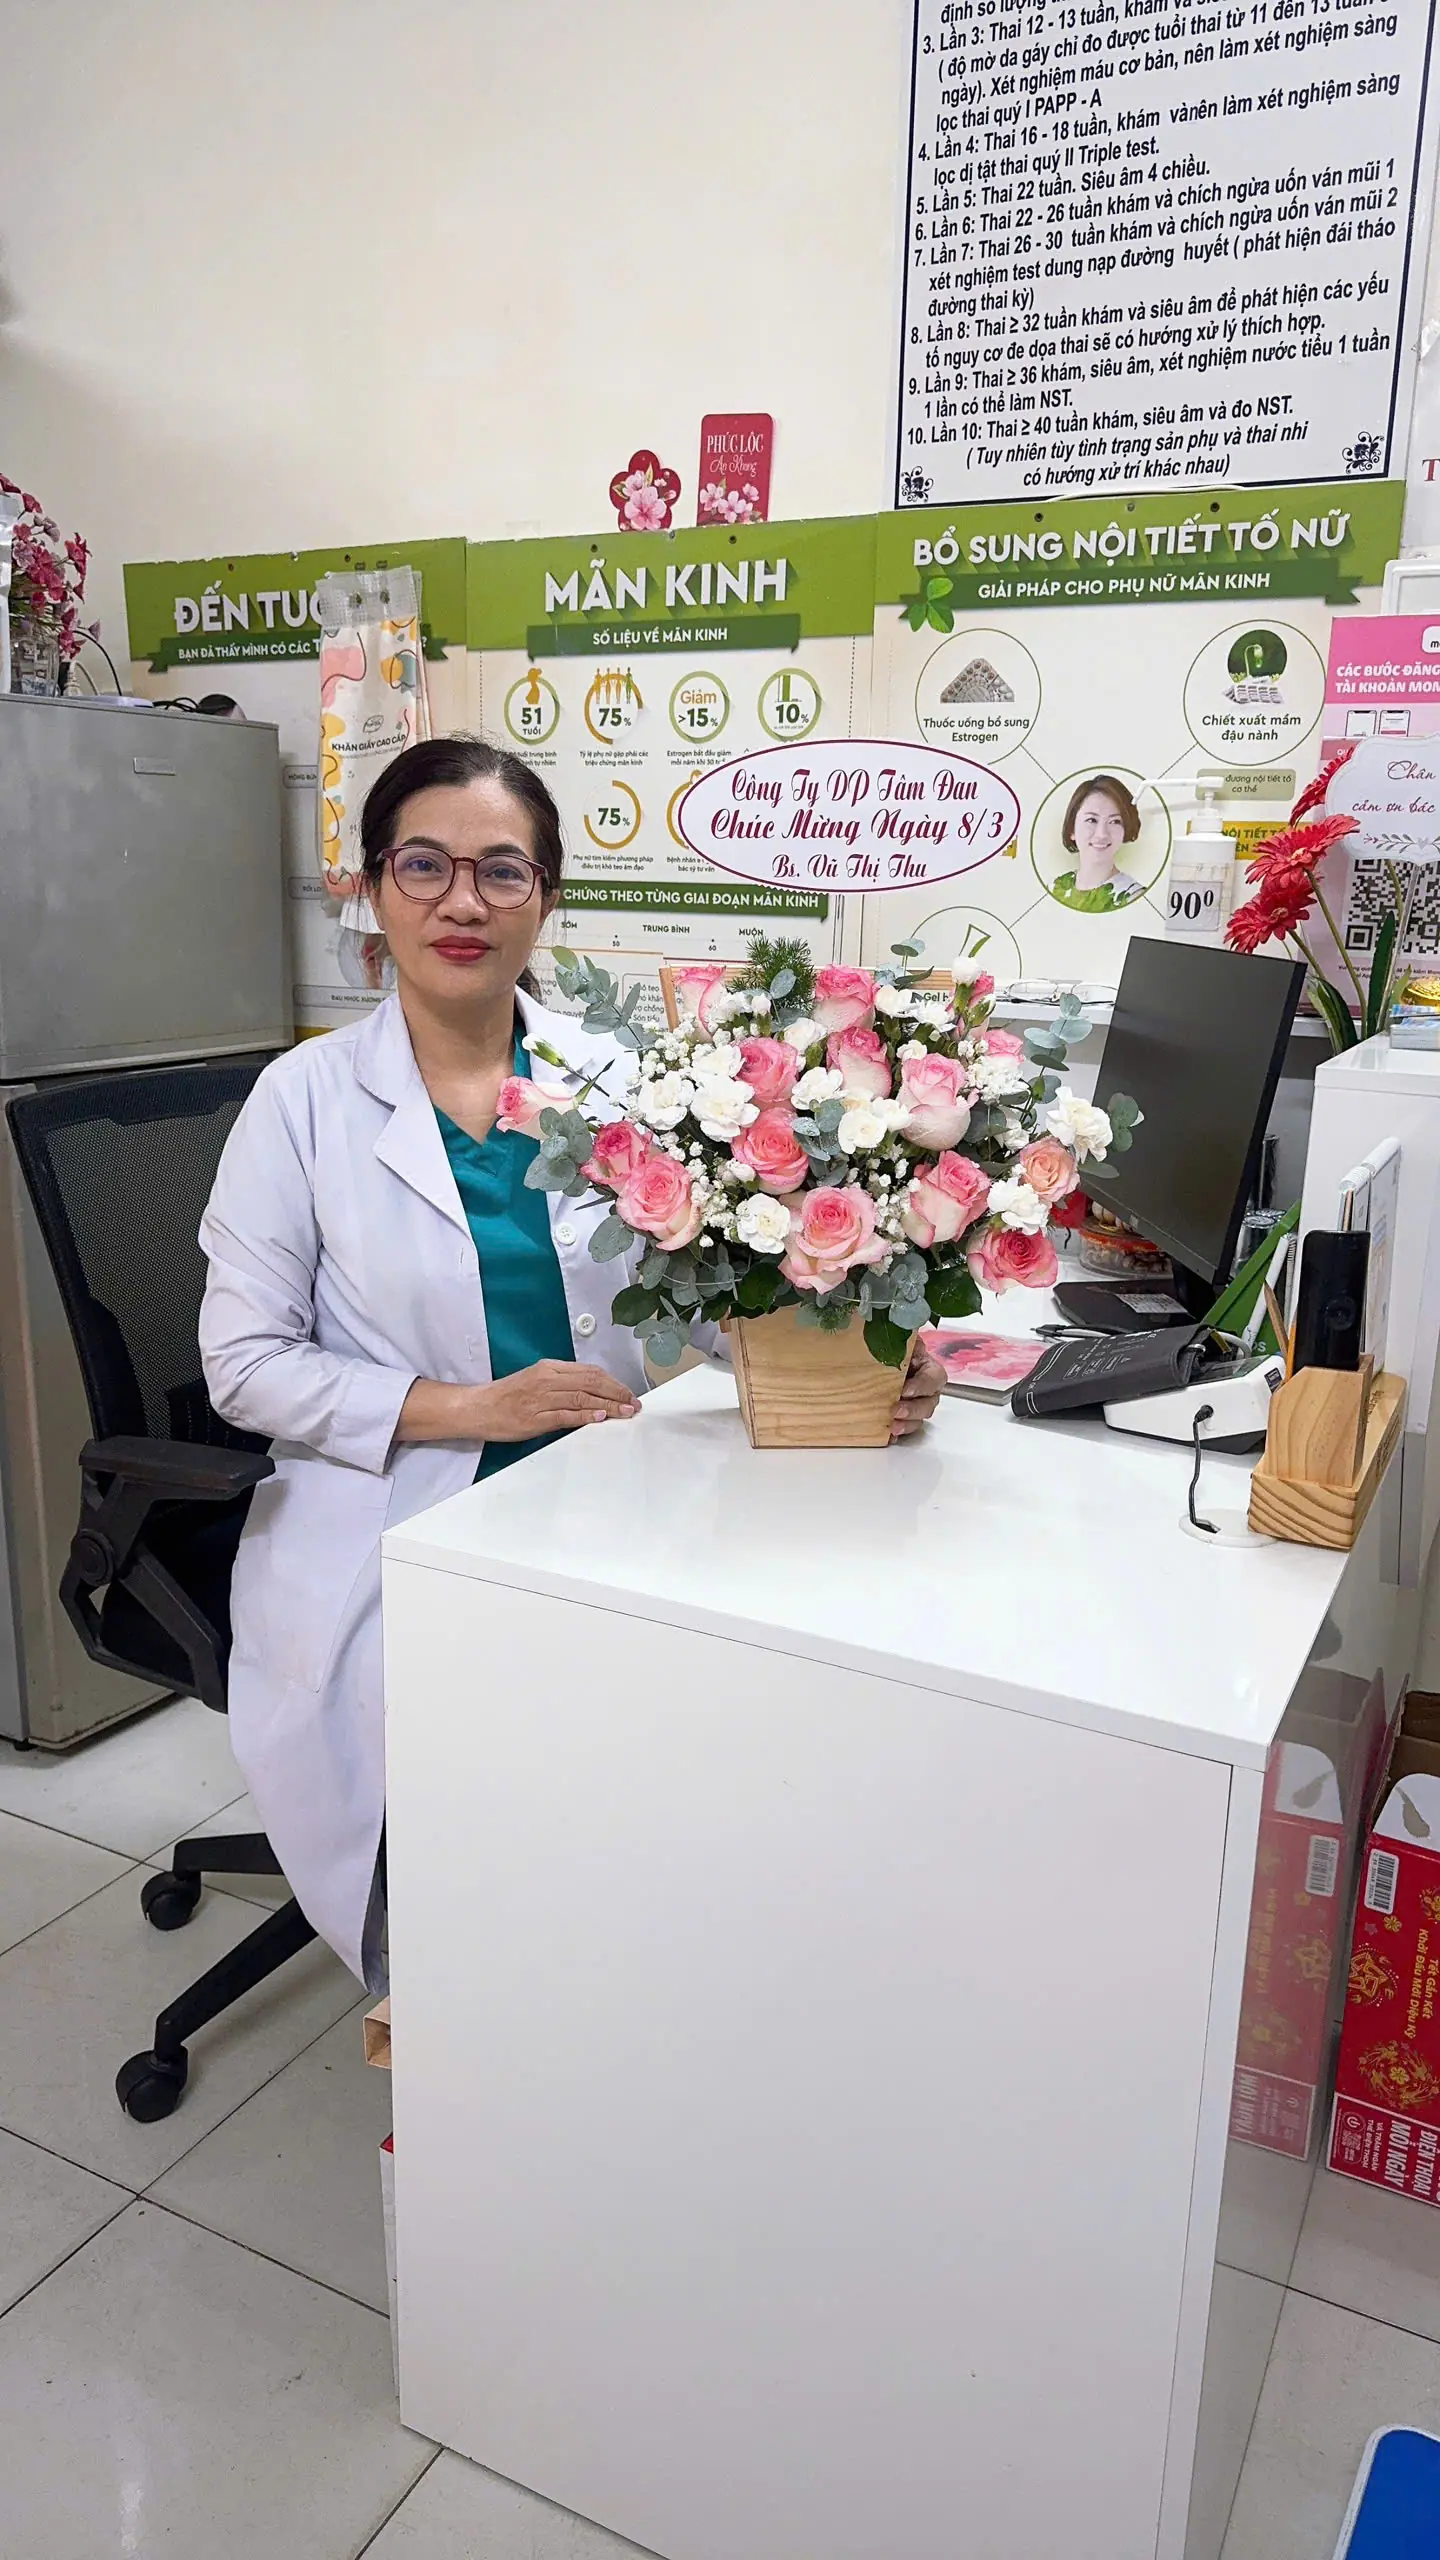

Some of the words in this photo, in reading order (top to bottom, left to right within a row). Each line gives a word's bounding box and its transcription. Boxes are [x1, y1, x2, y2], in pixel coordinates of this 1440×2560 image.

[942, 80, 986, 108] ngày).
[990, 75, 1015, 97] Xét
[1019, 66, 1076, 95] nghiệm
[1081, 59, 1114, 82] máu
[1119, 58, 1141, 75] cơ
[1145, 49, 1178, 71] bản,
[1184, 42, 1214, 65] nên
[1219, 38, 1249, 59] làm
[1253, 30, 1280, 54] xét
[1285, 21, 1348, 52] nghiệm
[1354, 14, 1397, 37] sàng
[916, 196, 928, 215] 5.
[933, 189, 959, 212] Lần
[964, 189, 976, 208] 5:
[981, 183, 1013, 205] Thai
[1017, 180, 1034, 200] 22
[1039, 172, 1076, 197] tuần.
[1081, 170, 1115, 191] Siêu
[1120, 167, 1143, 186] âm
[1148, 163, 1157, 182] 4
[1162, 153, 1210, 180] chiều.
[928, 296, 976, 317] đường
[981, 290, 1008, 311] thai
[1012, 287, 1034, 311] kỳ)
[926, 345, 940, 368] tố
[944, 350, 979, 370] nguy
[983, 347, 1003, 362] cơ
[1007, 342, 1024, 360] đe
[1029, 339, 1056, 361] dọa
[1061, 334, 1089, 354] thai
[1093, 332, 1110, 351] sẽ
[1115, 329, 1134, 349] có
[1138, 325, 1192, 347] hướng
[1196, 320, 1219, 341] xử
[1223, 318, 1237, 343] lý
[1242, 314, 1282, 336] thích
[1288, 313, 1325, 335] hợp.
[707, 432, 738, 453] PHÚC
[740, 432, 764, 455] LỘC
[912, 524, 959, 566] BỔ
[968, 532, 1063, 563] SUNG
[1073, 522, 1135, 571] NỘI
[1145, 513, 1221, 555] TIẾT
[1228, 508, 1280, 551] TỐ
[1291, 509, 1350, 548] NỮ
[544, 558, 647, 612] MÃN
[665, 558, 787, 608] KINH
[978, 578, 1011, 599] GIẢI
[1016, 577, 1060, 597] PHÁP
[1065, 577, 1103, 596] CHO
[1108, 576, 1144, 599] PHỤ
[1149, 572, 1176, 593] NỮ
[1180, 572, 1219, 591] MÃN
[1224, 573, 1271, 589] KINH
[174, 580, 249, 633] ĐẾN
[593, 628, 610, 645] SỐ
[613, 629, 641, 648] LIỆU
[643, 626, 660, 643] VỀ
[663, 627, 691, 643] MÃN
[695, 628, 728, 641] KINH
[1337, 663, 1361, 677] CÁC
[1364, 659, 1400, 676] BƯỚC
[680, 689, 717, 704] Giảm
[1336, 680, 1355, 693] TÀI
[1359, 678, 1405, 693] KHOẢN
[521, 707, 542, 725] 51
[923, 716, 955, 730] Thuốc
[958, 715, 987, 733] uống
[990, 715, 1002, 729] bổ
[1004, 717, 1030, 732] sung
[1202, 713, 1235, 727] Chiết
[1238, 713, 1266, 727] xuất
[1270, 711, 1301, 726] mầm
[951, 731, 999, 745] Estrogen
[1221, 728, 1245, 743] đậu
[1248, 728, 1279, 742] nành
[1387, 760, 1437, 780] Chân
[732, 768, 783, 809] Công
[791, 768, 820, 808] Ty
[827, 768, 870, 808] DP
[877, 768, 925, 801] Tâm
[933, 768, 978, 801] Đan
[711, 808, 775, 840] Chúc
[781, 808, 861, 846] Mừng
[871, 808, 949, 846] Ngày
[957, 808, 1004, 846] 8/3
[772, 854, 800, 878] Bs.
[807, 854, 839, 878] Vũ
[846, 853, 880, 883] Thị
[888, 853, 927, 878] Thu
[563, 886, 608, 901] CHỨNG
[610, 890, 643, 903] THEO
[645, 888, 680, 904] TỪNG
[683, 892, 709, 905] GIAI
[712, 893, 750, 909] ĐOẠN
[753, 892, 782, 907] MÃN
[786, 895, 819, 908] KINH
[642, 925, 669, 933] TRUNG
[671, 924, 690, 934] BÌNH
